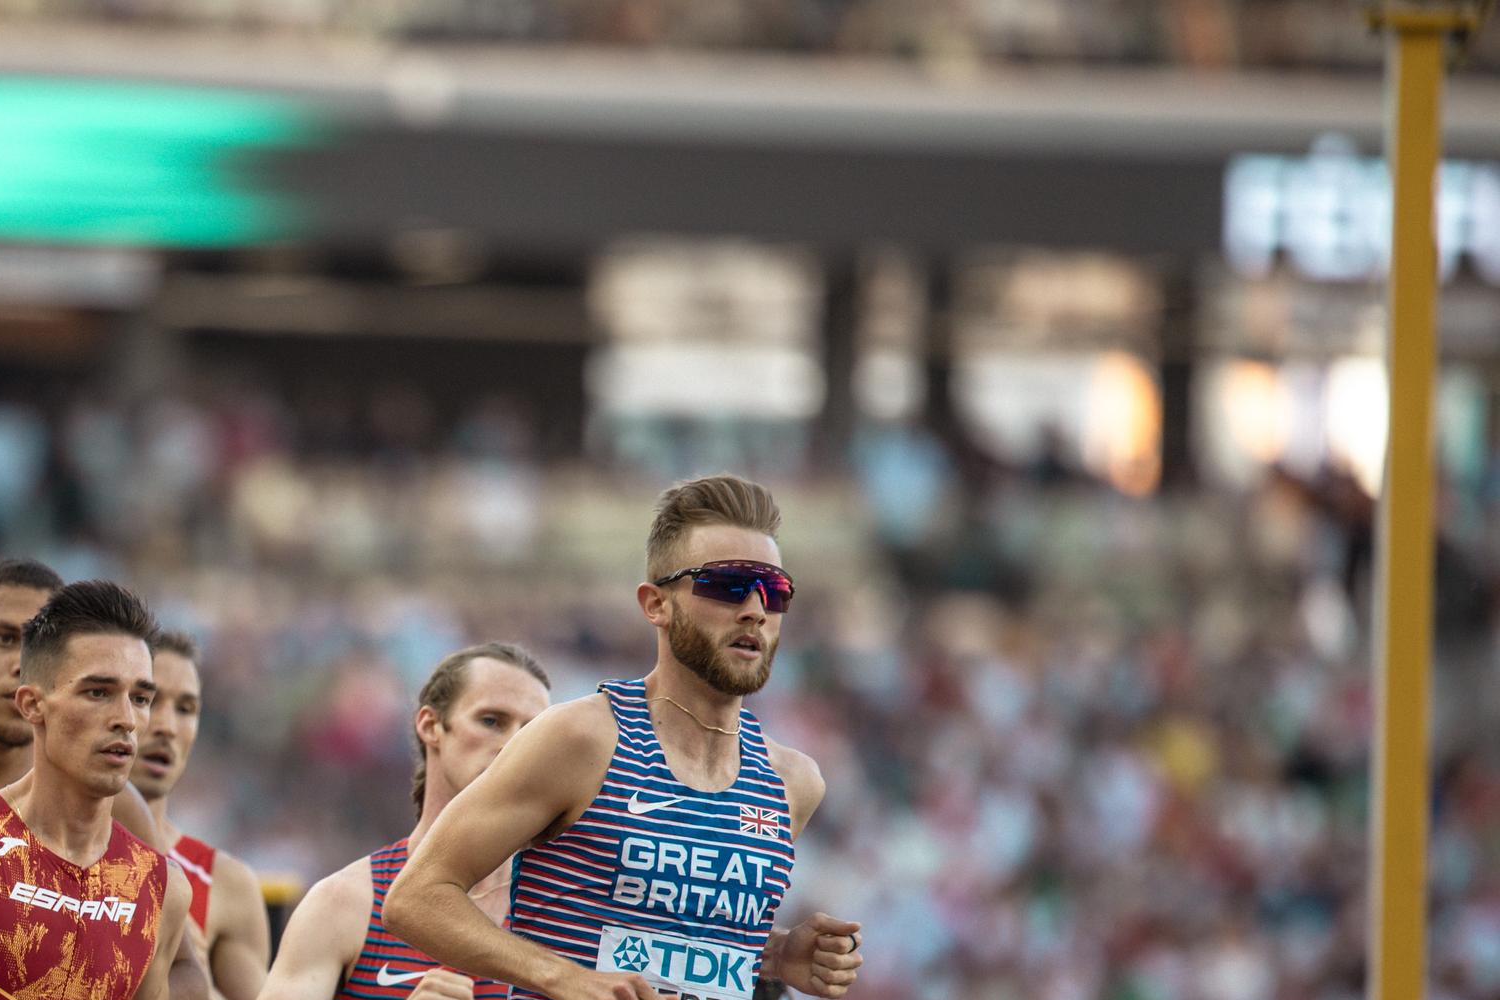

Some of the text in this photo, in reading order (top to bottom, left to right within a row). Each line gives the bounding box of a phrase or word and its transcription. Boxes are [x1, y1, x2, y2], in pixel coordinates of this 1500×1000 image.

[620, 836, 771, 889] GREAT
[9, 881, 137, 925] ESPAÑA
[612, 873, 769, 927] BRITAIN
[651, 939, 747, 992] TDK
